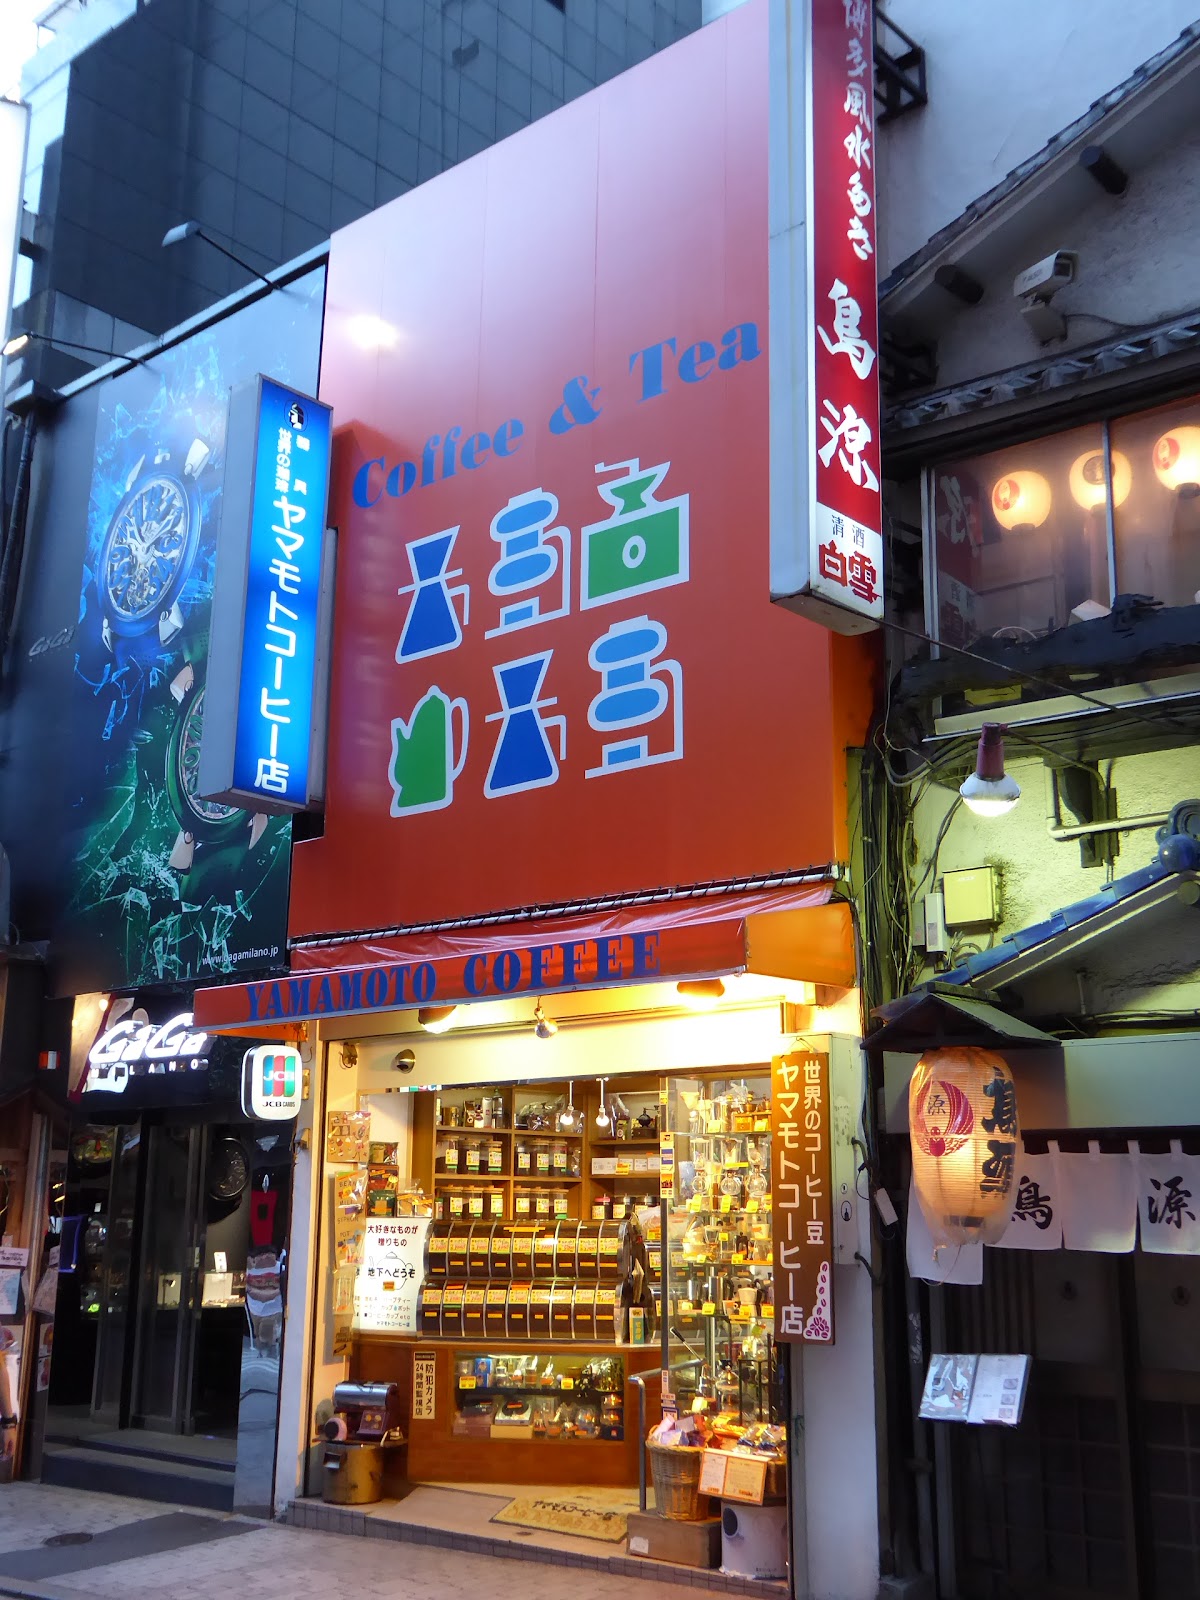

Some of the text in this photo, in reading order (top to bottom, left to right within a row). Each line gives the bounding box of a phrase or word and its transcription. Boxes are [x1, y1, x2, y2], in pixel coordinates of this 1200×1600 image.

[351, 321, 762, 509] Coffee & Tea
[831, 514, 866, 549] 清酒
[818, 539, 881, 604] 白雪
[253, 496, 307, 794] ヤマモトコーヒー店
[245, 930, 661, 1022] YAMAMOTO COFFEE
[263, 1070, 296, 1082] JCB
[803, 1060, 825, 1245] 世界のコーヒー豆
[776, 1061, 804, 1335] ヤマモトコーヒー店
[1010, 1175, 1196, 1230] 鳥 源
[367, 1225, 419, 1235] 大好きなものが
[377, 1238, 408, 1247] 贈りもの
[367, 1267, 416, 1279] 地下へどうぞ
[425, 1363, 434, 1415] 防犯カメラ
